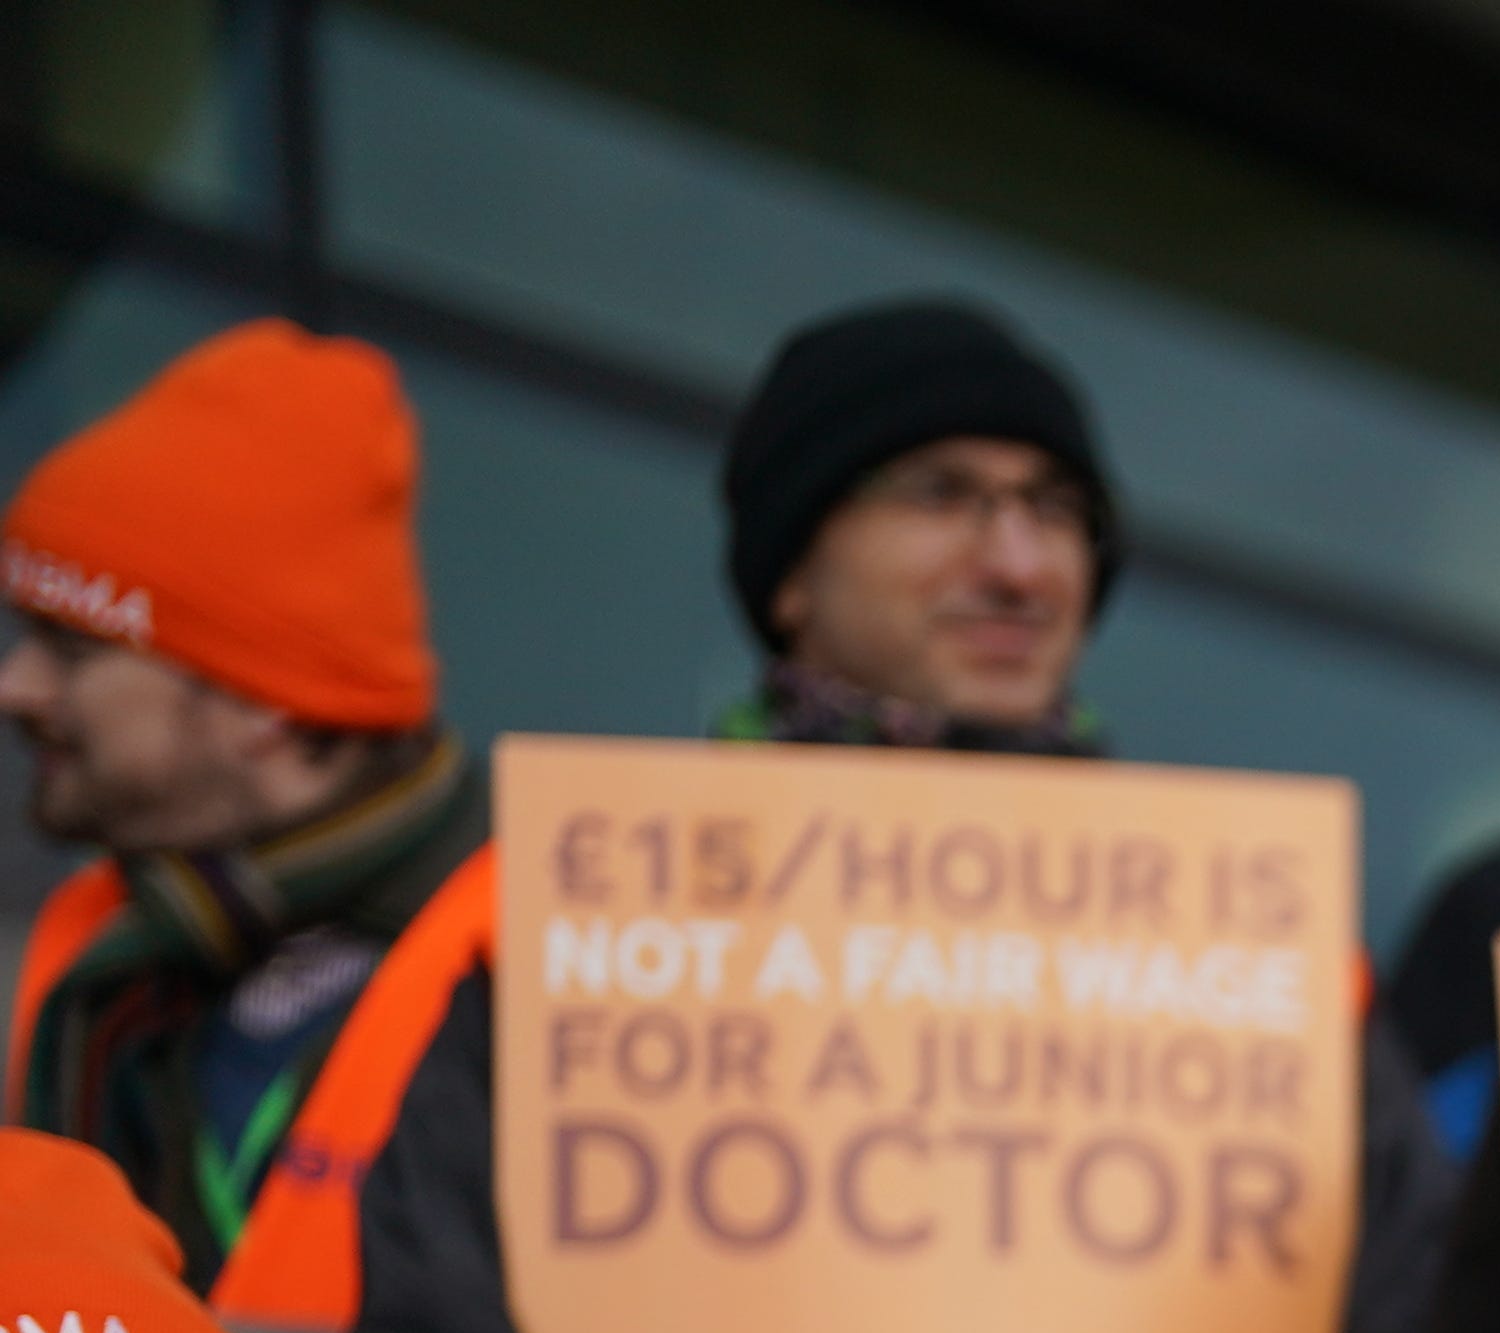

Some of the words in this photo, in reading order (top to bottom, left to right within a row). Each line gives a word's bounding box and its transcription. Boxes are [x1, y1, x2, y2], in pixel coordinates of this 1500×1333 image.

[552, 808, 1176, 930] £15/HOUR
[1211, 836, 1310, 938] IS
[542, 918, 740, 999] NOT
[756, 925, 824, 1005] A
[843, 928, 1045, 1015] FAIR
[1058, 942, 1308, 1034] WAGE
[548, 1012, 775, 1101] FOR
[809, 1016, 881, 1098] A
[914, 1016, 1307, 1129] JUNIOR
[549, 1116, 1308, 1280] DOCTOR
